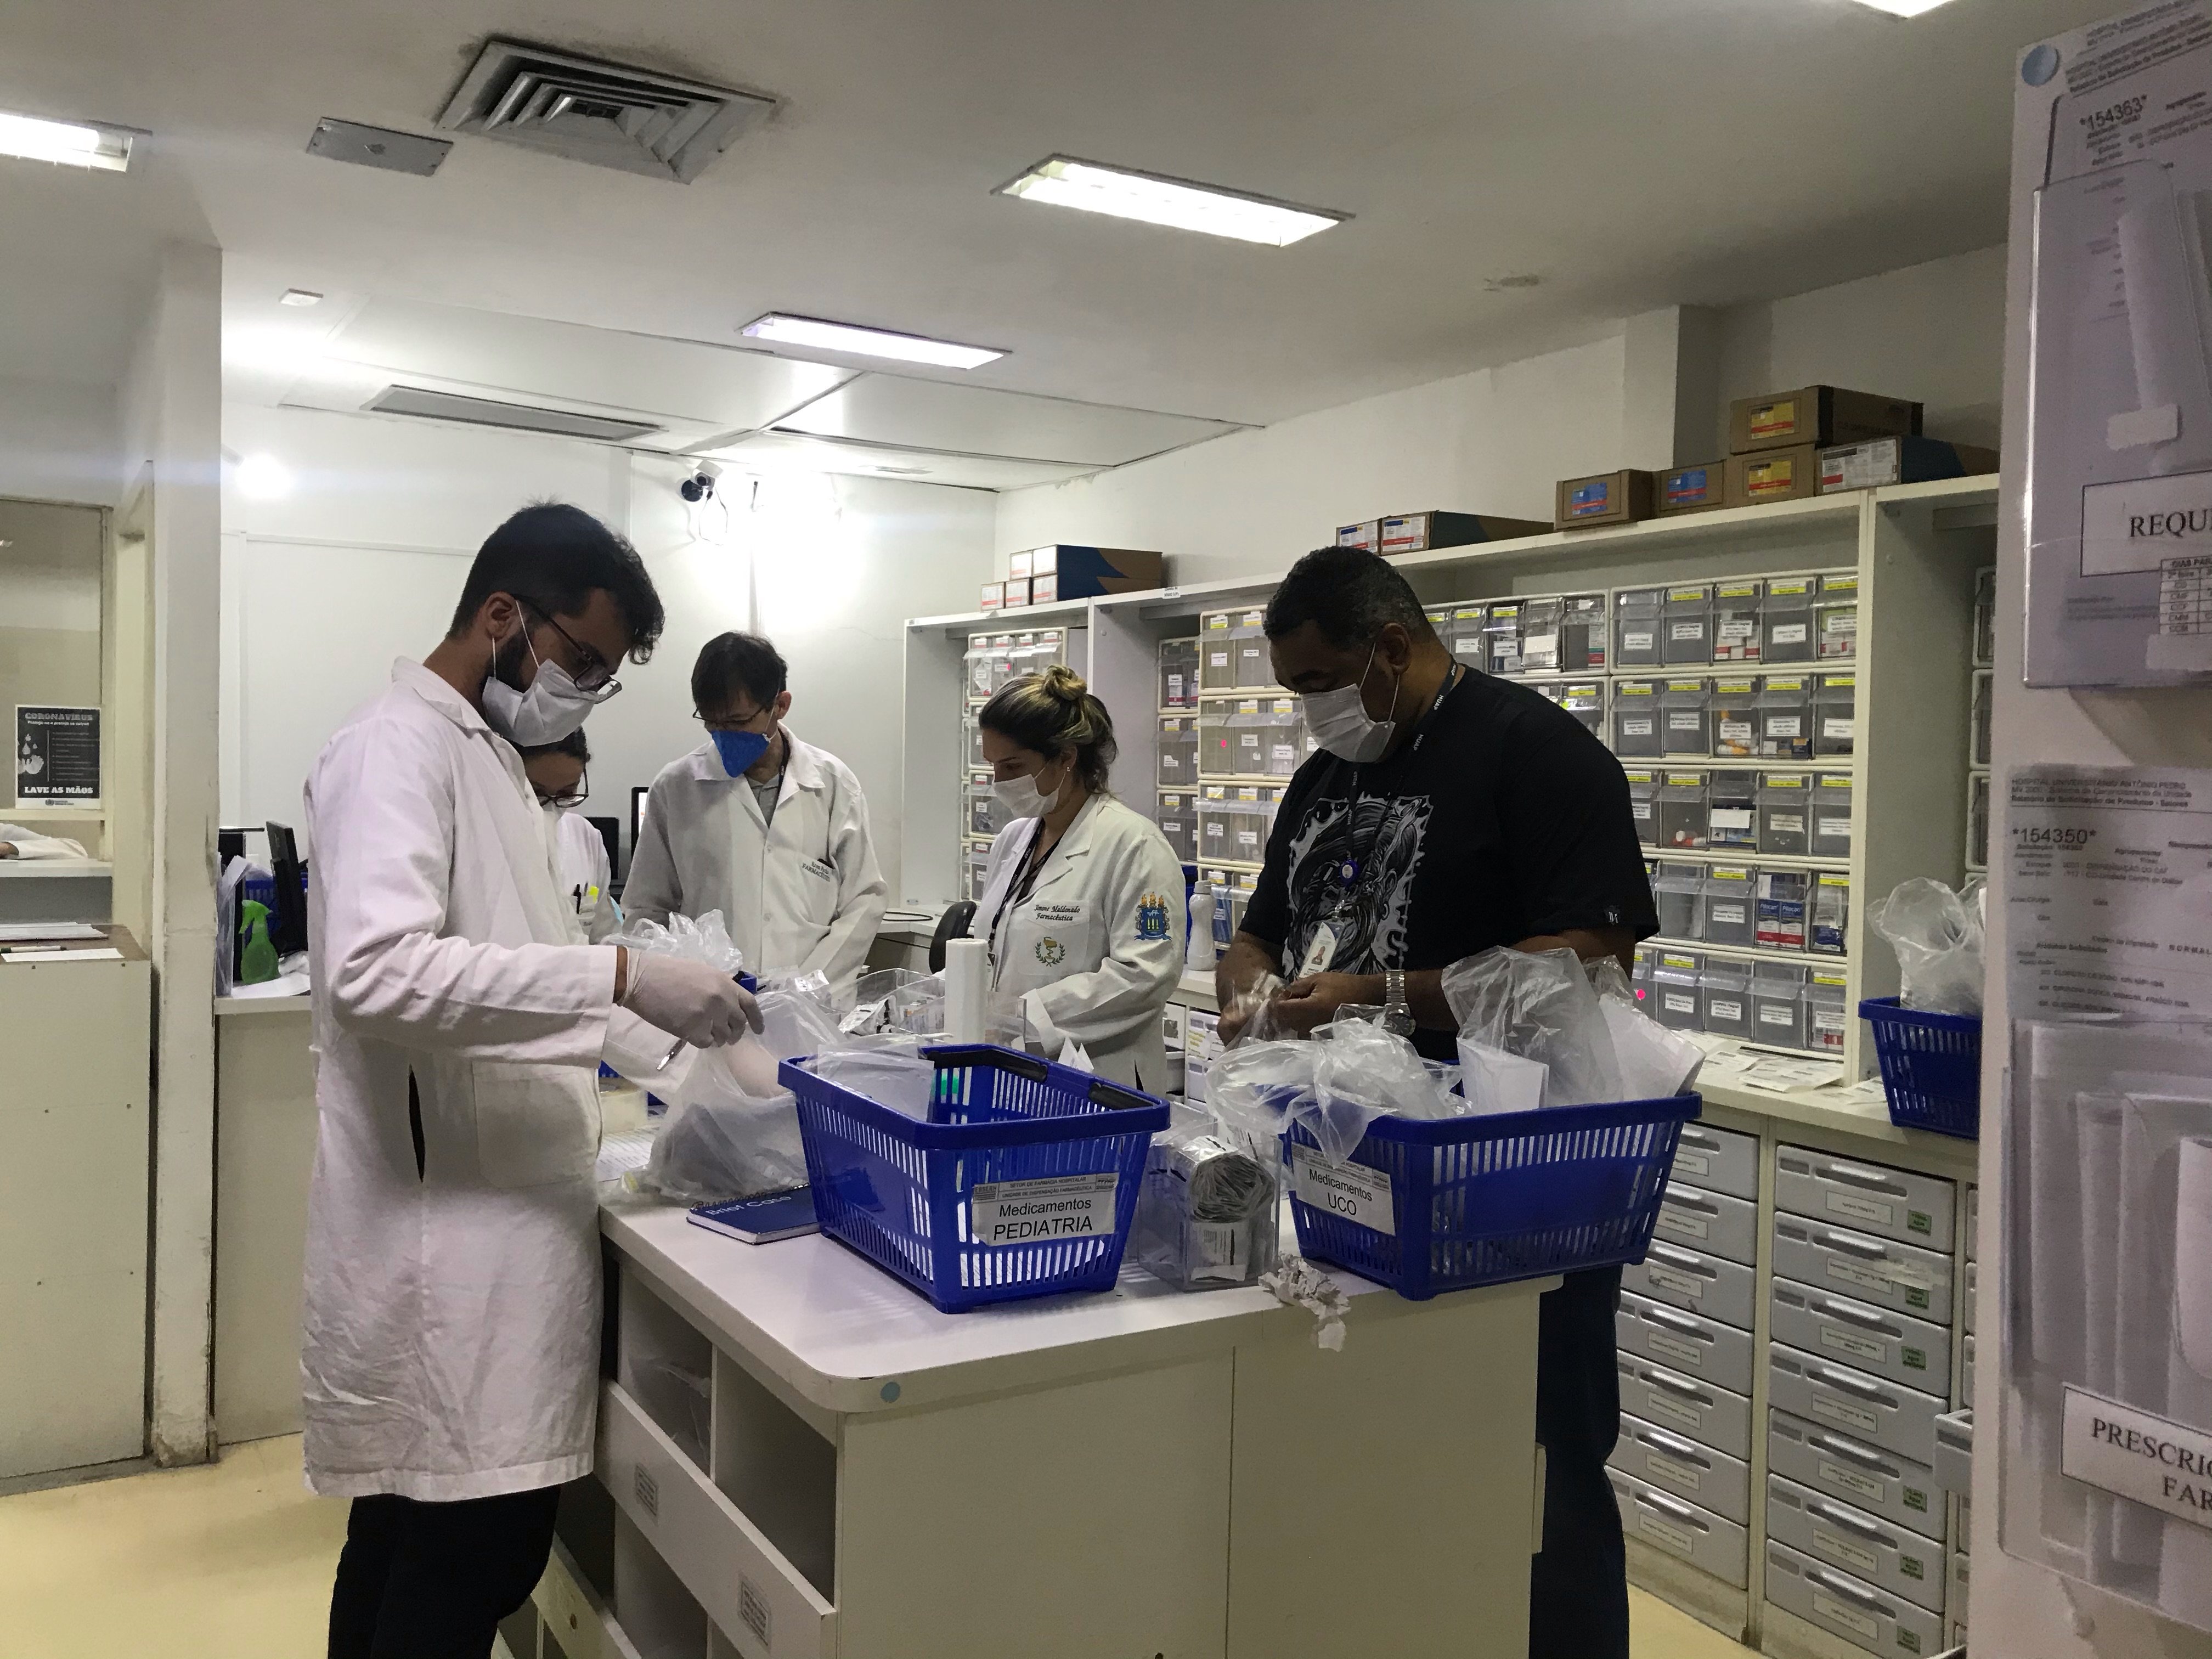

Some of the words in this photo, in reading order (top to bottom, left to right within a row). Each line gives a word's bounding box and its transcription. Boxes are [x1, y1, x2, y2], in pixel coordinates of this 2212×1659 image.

[1434, 695, 1444, 710] HUAP
[65, 786, 93, 794] MÃOS
[1309, 1169, 1373, 1201] Medicamentos
[746, 1196, 792, 1207] Case
[999, 1198, 1092, 1217] Medicamentos
[1328, 1192, 1357, 1216] UCO
[994, 1216, 1093, 1241] PEDIATRIA
